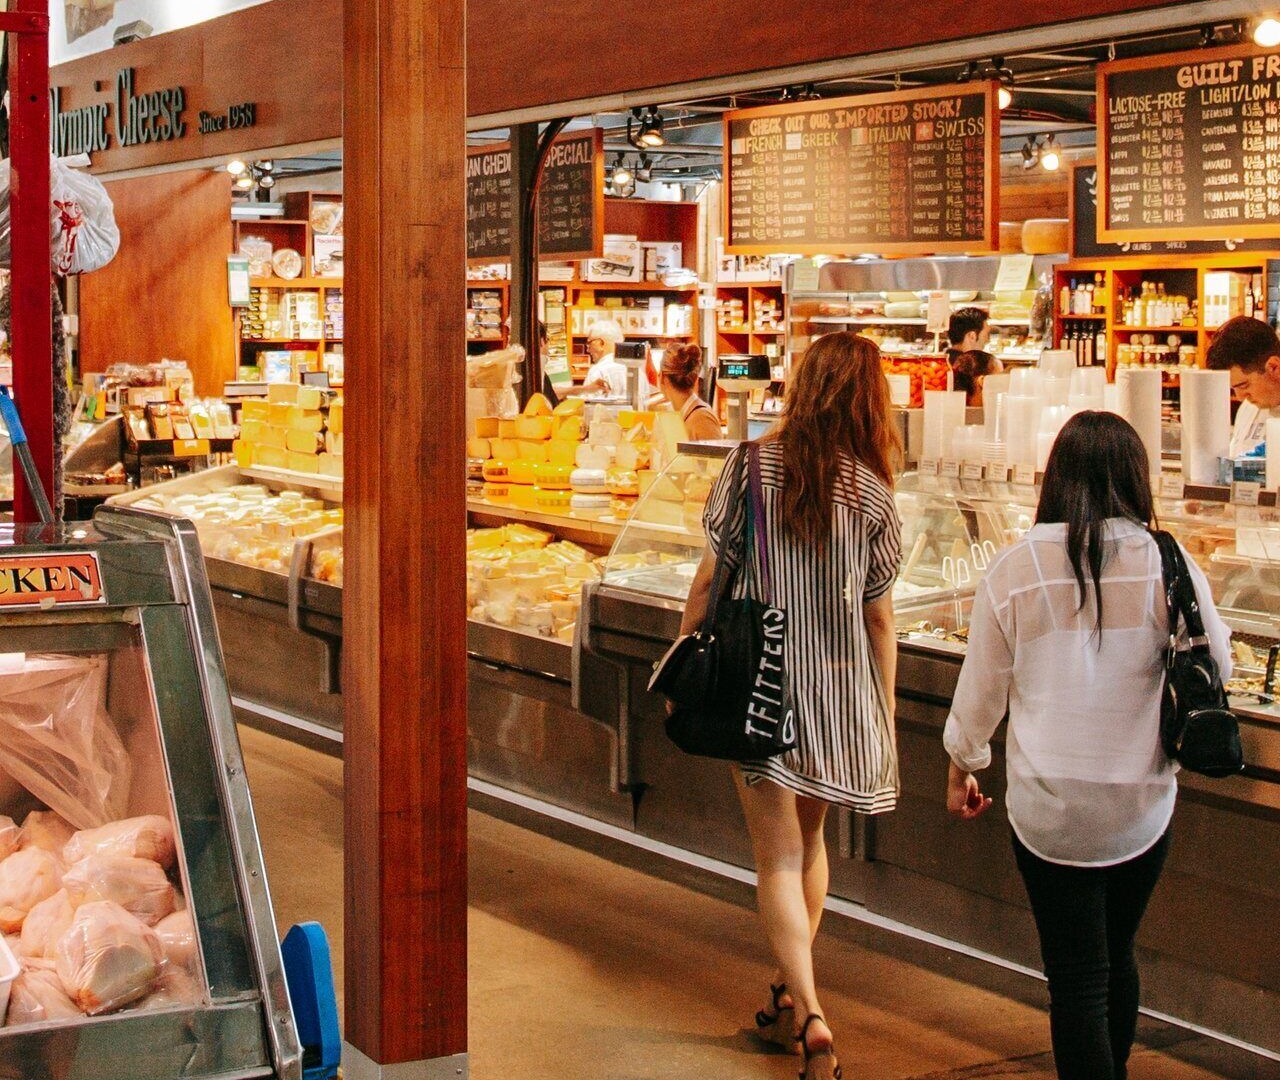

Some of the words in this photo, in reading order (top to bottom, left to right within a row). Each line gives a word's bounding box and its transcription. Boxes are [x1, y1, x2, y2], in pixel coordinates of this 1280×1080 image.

[1177, 60, 1243, 88] GUILT
[1109, 91, 1186, 115] LACTOSE-FREE
[1201, 84, 1271, 106] LIGHT/LOW
[50, 80, 108, 157] lympic
[115, 67, 187, 147] Cheese
[198, 110, 223, 134] Since
[227, 103, 256, 130] 1958
[835, 104, 909, 129] IMPORTED
[913, 98, 962, 121] STOCK!
[868, 125, 911, 144] ITALIAN
[934, 117, 985, 138] SWISS
[745, 134, 782, 153] FRENCH
[802, 132, 839, 148] GREEK
